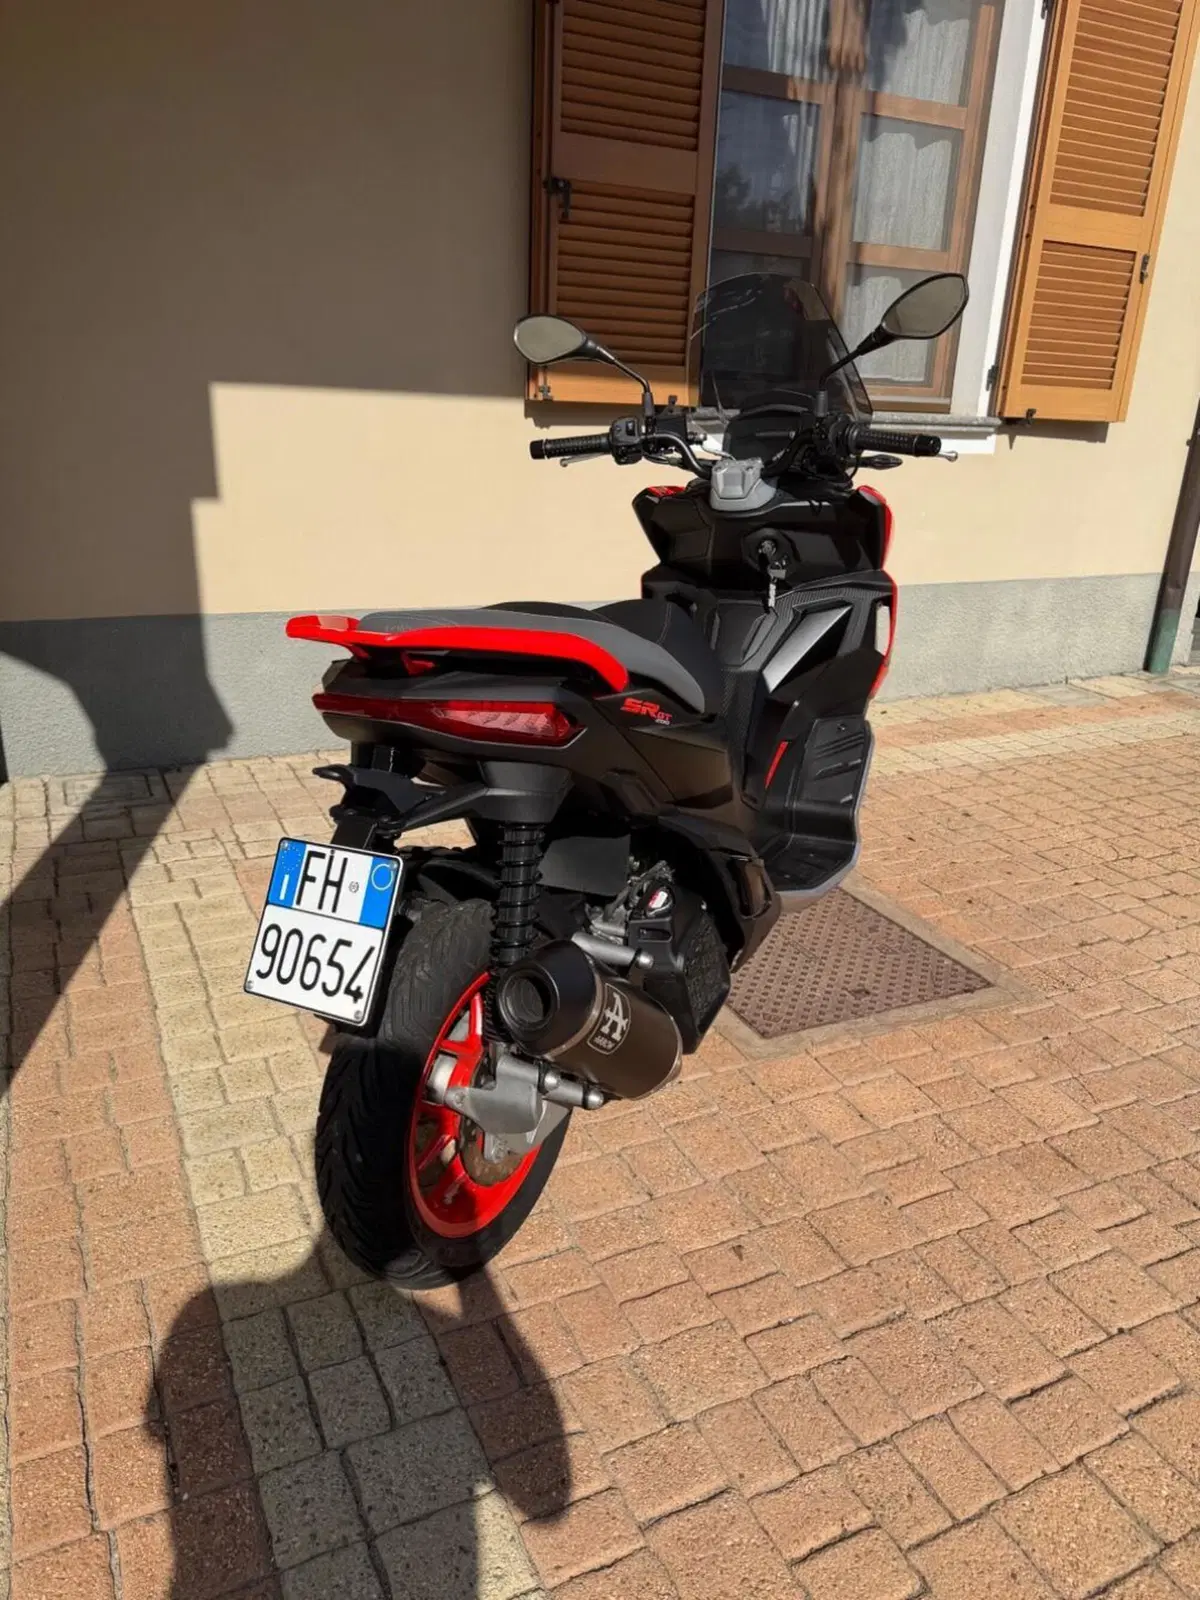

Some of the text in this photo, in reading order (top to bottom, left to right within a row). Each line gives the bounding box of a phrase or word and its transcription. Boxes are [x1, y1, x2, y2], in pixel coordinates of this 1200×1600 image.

[620, 697, 660, 718] SR
[295, 850, 348, 913] FH
[255, 923, 375, 1003] 90654
